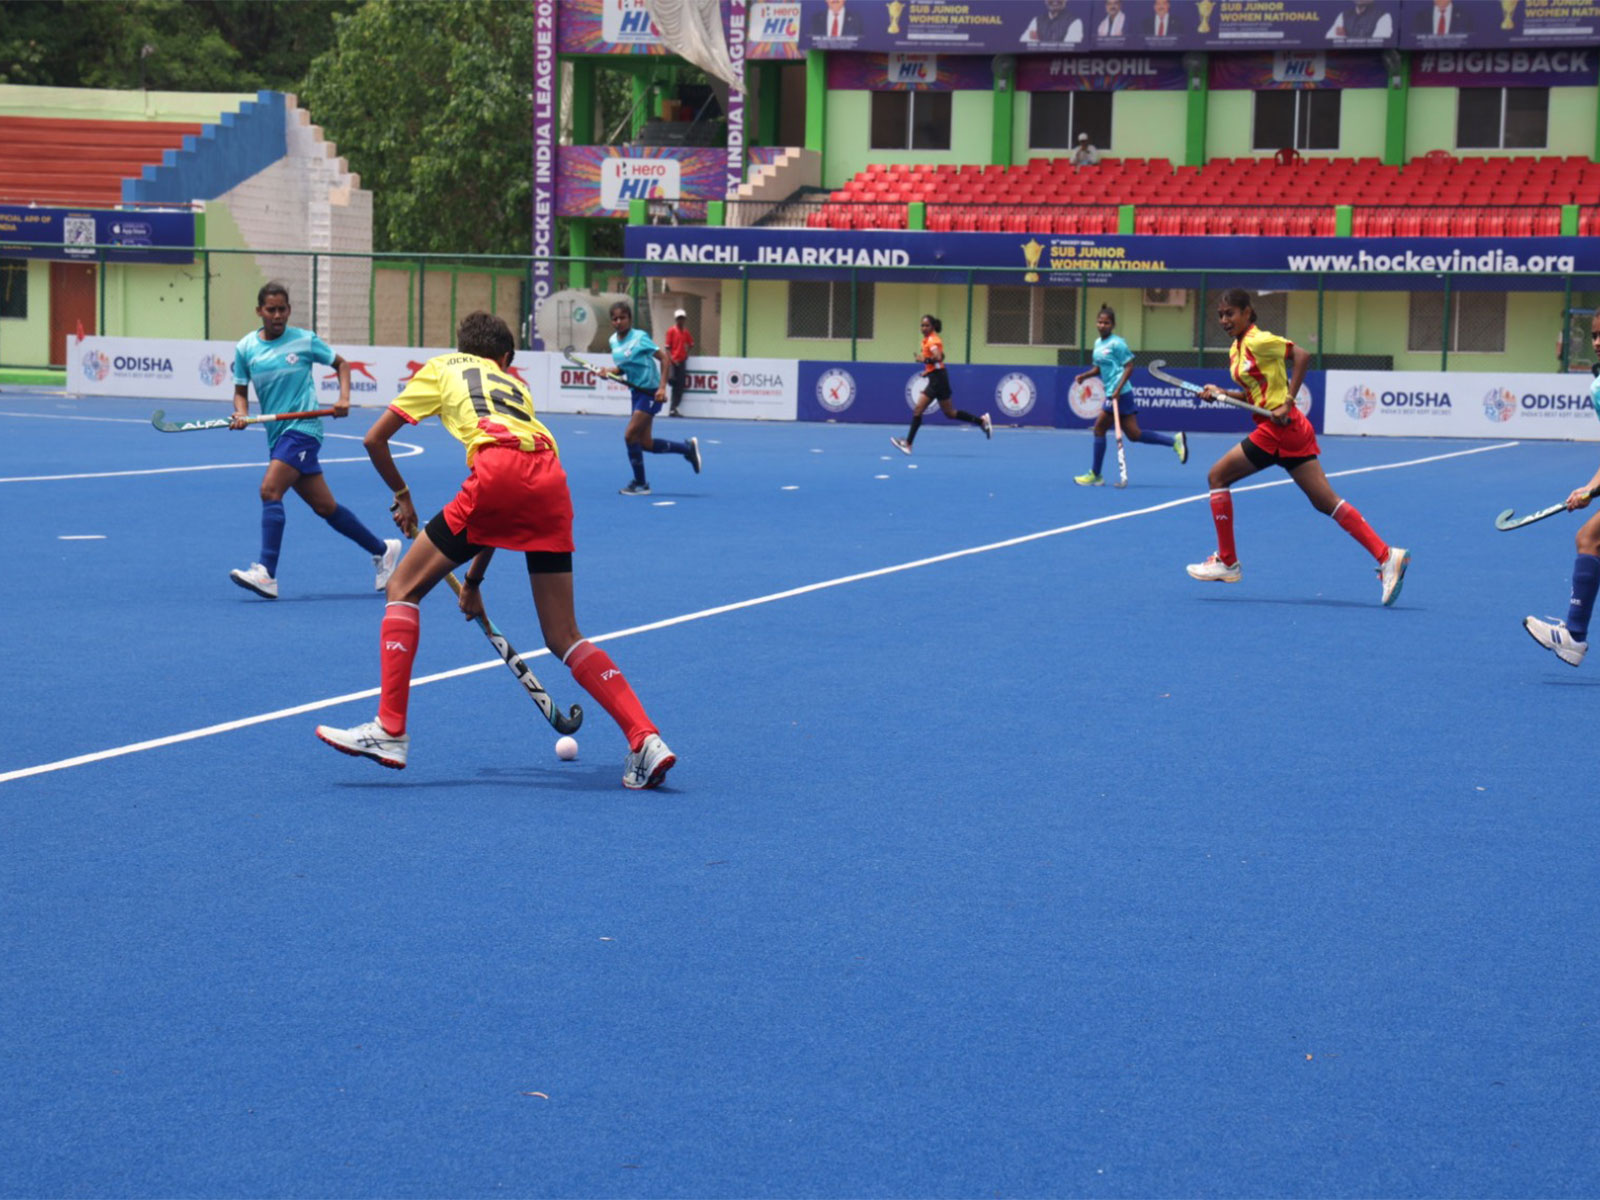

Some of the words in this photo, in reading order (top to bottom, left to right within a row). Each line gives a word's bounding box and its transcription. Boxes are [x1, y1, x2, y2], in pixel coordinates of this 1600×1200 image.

[538, 0, 553, 28] 20
[909, 5, 930, 14] SUB
[931, 5, 969, 14] JUNIOR
[1220, 3, 1242, 12] SUB
[1244, 2, 1284, 11] JUNIOR
[1525, 8, 1570, 17] WOMEN
[909, 15, 949, 25] WOMEN
[950, 15, 1003, 25] NATIONAL
[1220, 12, 1261, 22] WOMEN
[1264, 11, 1319, 22] NATIONAL
[1050, 58, 1157, 76] #HEROHIL
[1420, 52, 1589, 73] #BIGISBACK
[537, 31, 552, 118] LEAGUE
[727, 108, 743, 168] INDIA
[536, 123, 551, 183] INDIA
[632, 165, 666, 176] Hero
[535, 188, 550, 276] HOCKEY
[751, 246, 910, 268] JHARKHAND
[1051, 246, 1076, 258] SUB
[1078, 247, 1125, 259] JUNIOR
[1050, 258, 1100, 270] WOMEN
[1102, 260, 1168, 271] NATIONAL
[114, 356, 173, 372] ODISHA
[561, 369, 597, 386] OMC
[462, 367, 531, 422] 12
[1381, 391, 1452, 407] ODISHA
[1522, 393, 1594, 410] ODISHA
[1152, 398, 1197, 409] AFFAIRS,
[181, 418, 229, 430] ALFA
[491, 634, 552, 719] ALFA
